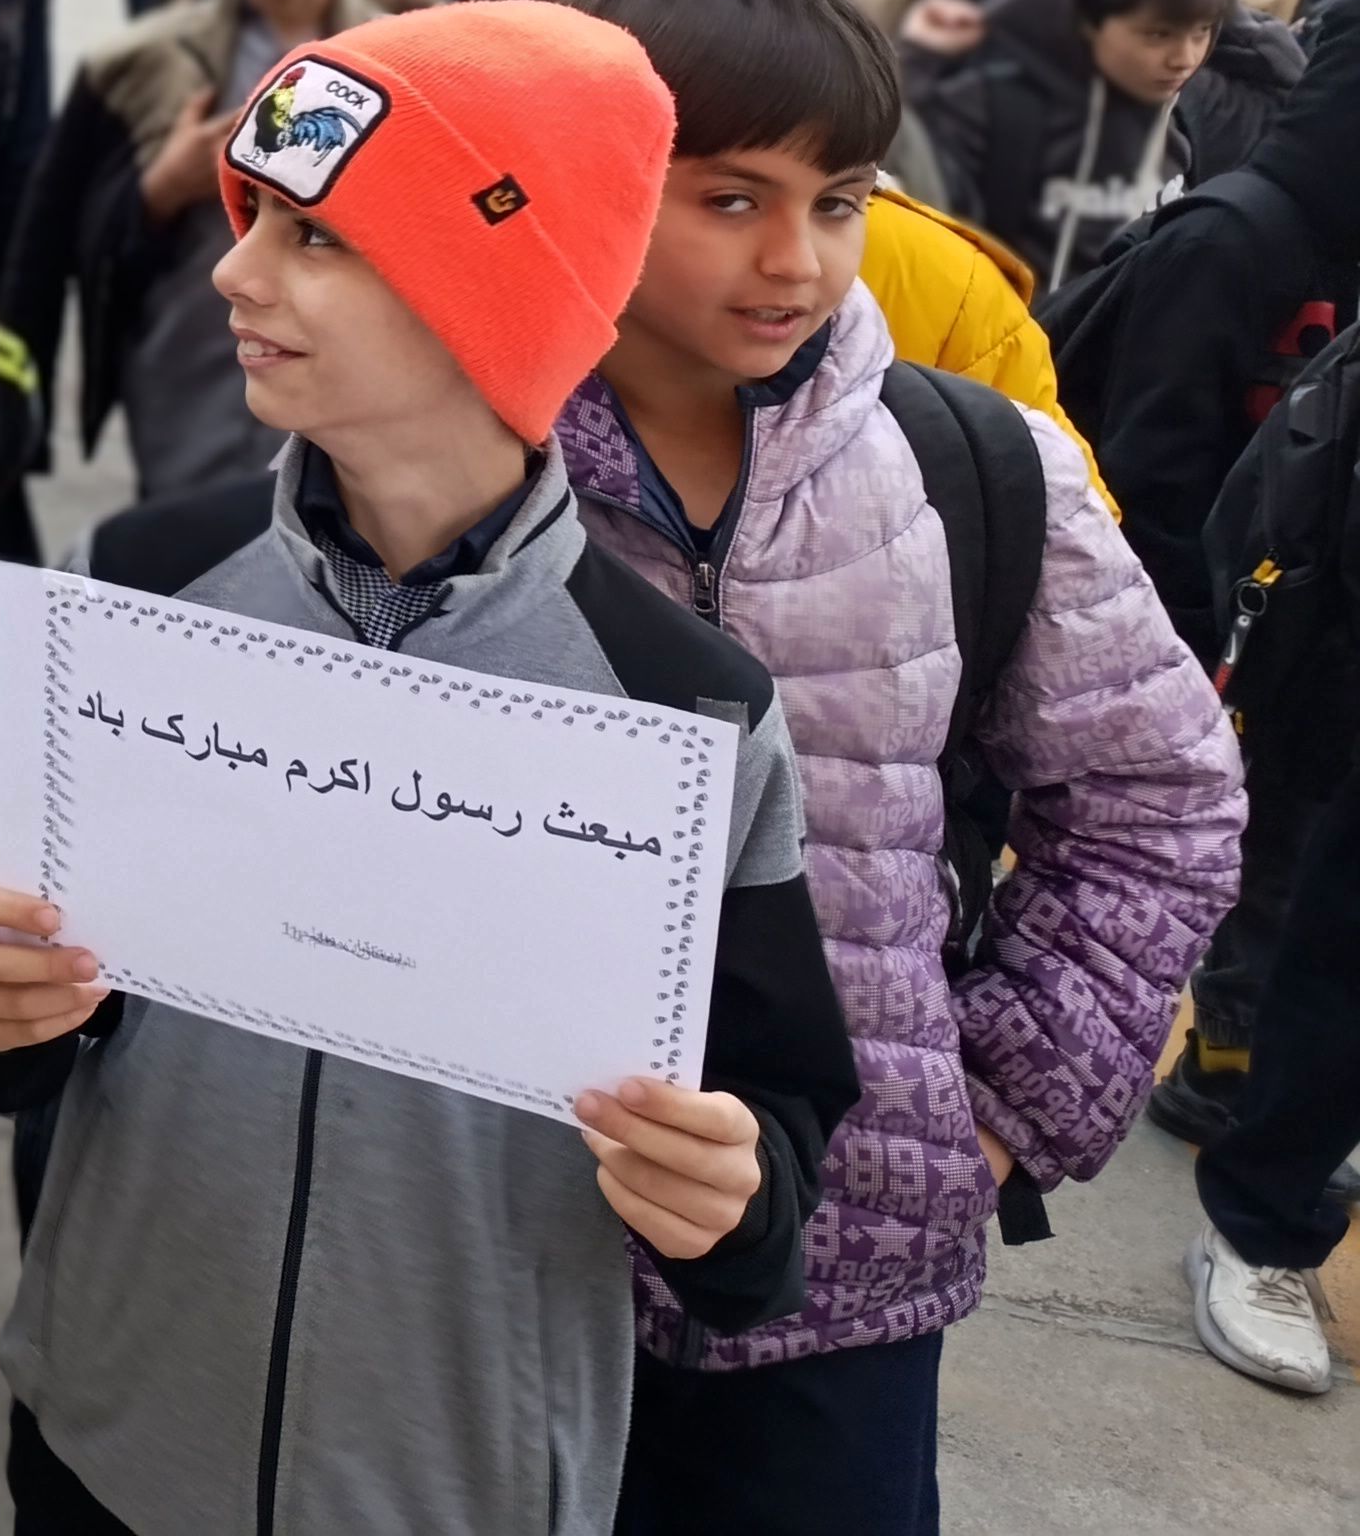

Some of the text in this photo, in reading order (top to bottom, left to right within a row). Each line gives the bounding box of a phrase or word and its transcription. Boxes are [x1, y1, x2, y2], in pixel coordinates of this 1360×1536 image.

[326, 80, 370, 110] COCK
[78, 691, 661, 860] مبعث رسول اکرم مبارک باد
